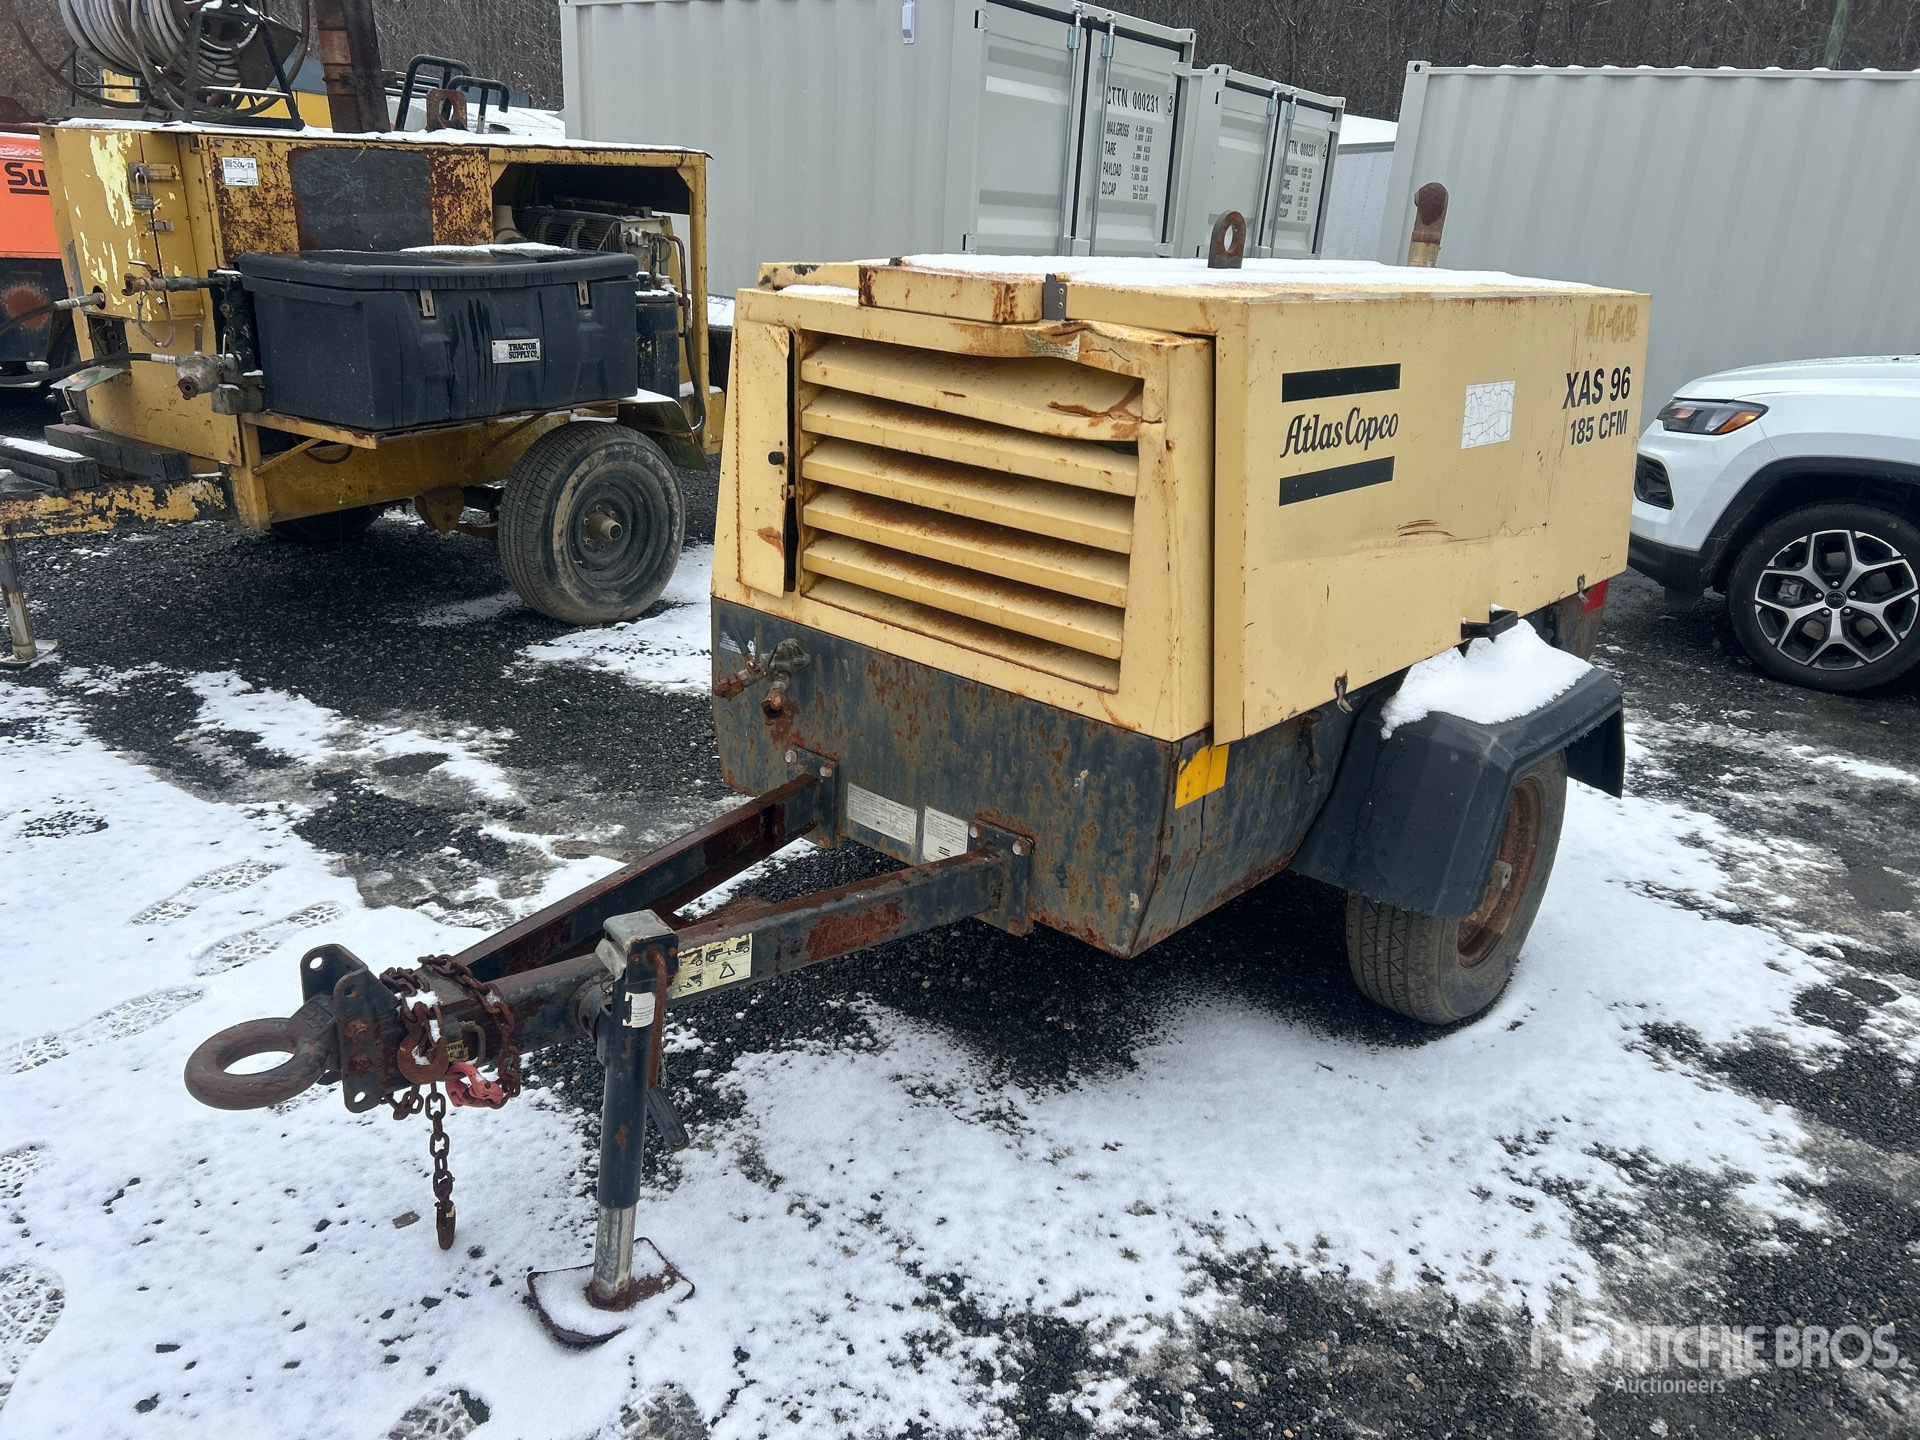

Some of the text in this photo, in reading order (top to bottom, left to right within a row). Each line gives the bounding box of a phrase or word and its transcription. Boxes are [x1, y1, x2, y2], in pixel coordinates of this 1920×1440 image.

[1133, 91, 1159, 113] 000231
[1168, 95, 1174, 113] 3
[1105, 141, 1117, 155] TARE
[5, 162, 48, 187] Su
[1103, 161, 1122, 176] PAYLOAD
[508, 343, 537, 351] TRACTOR
[509, 350, 530, 359] SUPPLY
[1562, 366, 1631, 409] XAS 96
[1571, 409, 1628, 445] 185 CFM
